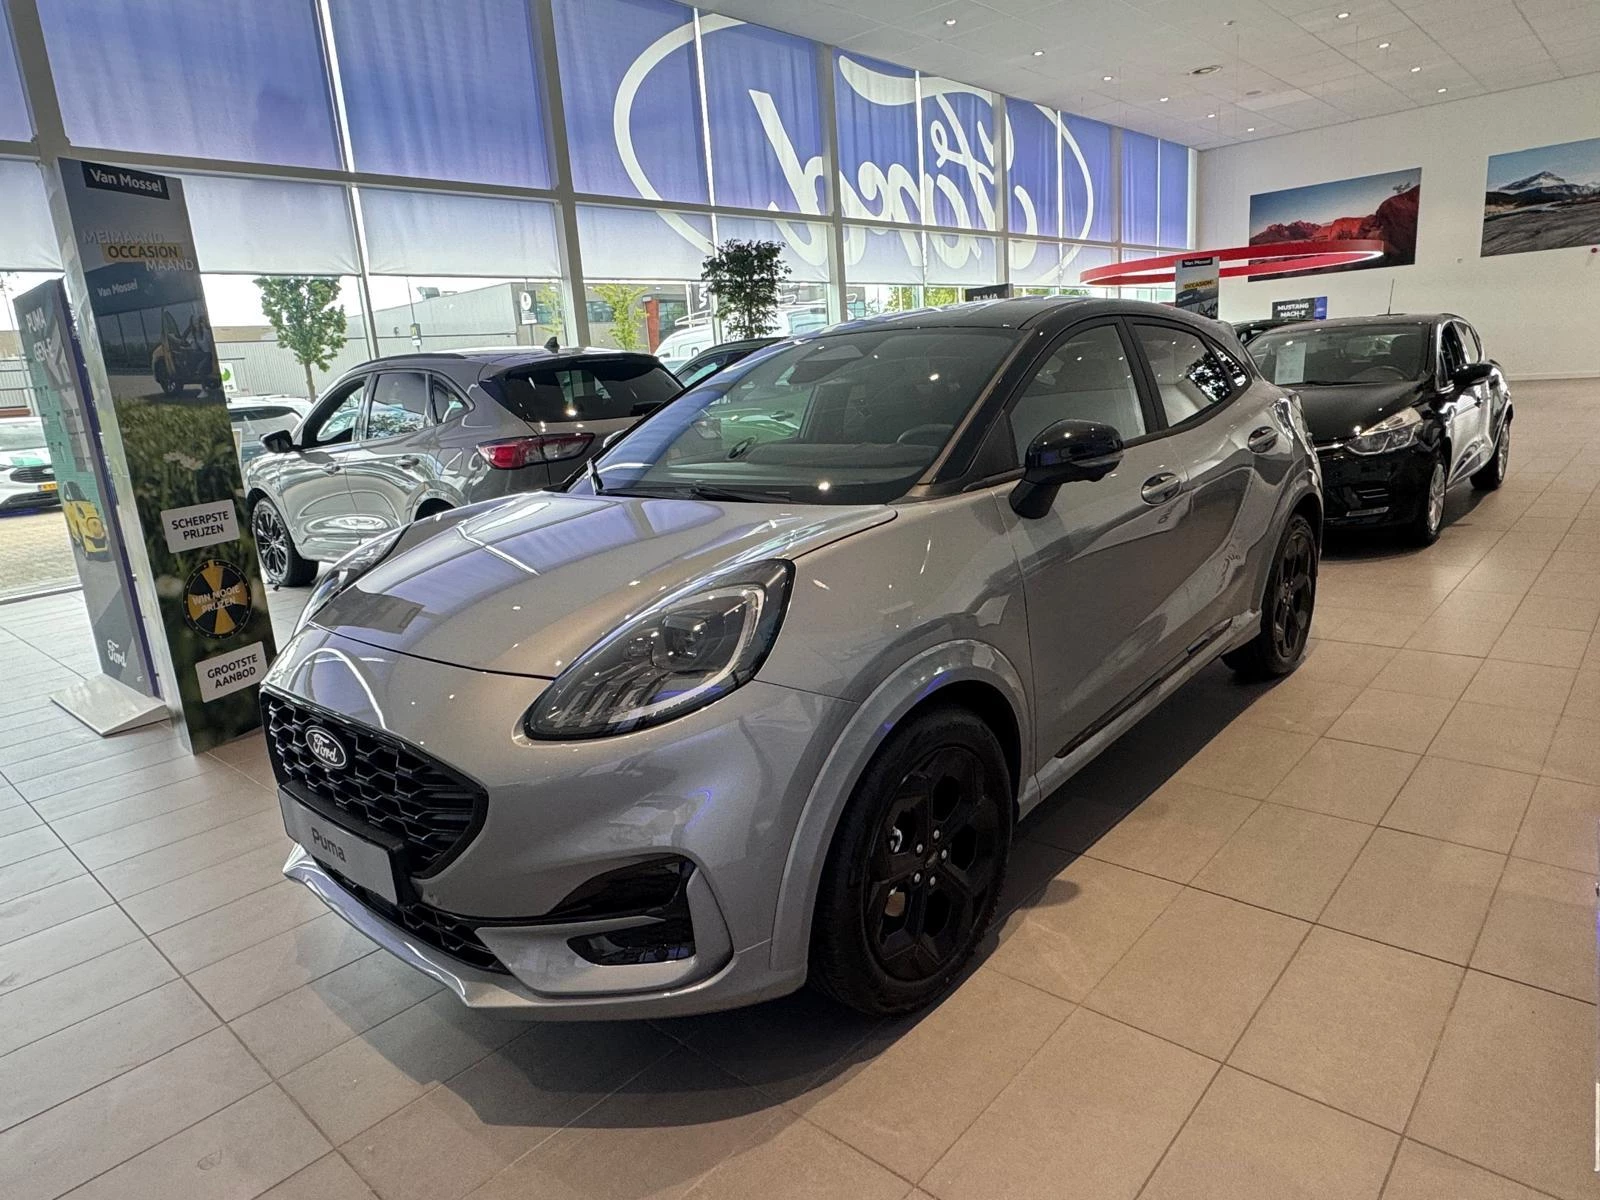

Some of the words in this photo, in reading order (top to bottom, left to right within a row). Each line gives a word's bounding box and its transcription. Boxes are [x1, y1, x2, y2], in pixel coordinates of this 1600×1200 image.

[89, 168, 117, 184] Van
[120, 173, 163, 192] Mossel
[107, 245, 178, 259] OCCASION
[145, 260, 194, 272] MAAND
[97, 286, 112, 297] Van
[112, 279, 138, 295] Mossel
[973, 293, 998, 302] PUMA
[1277, 302, 1310, 311] MUSTANG
[25, 307, 47, 334] PUMA
[171, 510, 230, 530] SCHERPSTE
[183, 523, 225, 540] PRIJZEN
[191, 591, 212, 606] WIN
[212, 585, 240, 599] MOOIE
[201, 597, 237, 614] PRIJZEN
[107, 639, 127, 668] Ford
[207, 653, 258, 679] GROOTSTE
[214, 666, 256, 689] AANBOD
[311, 732, 338, 763] Ford
[311, 826, 347, 863] Puma
